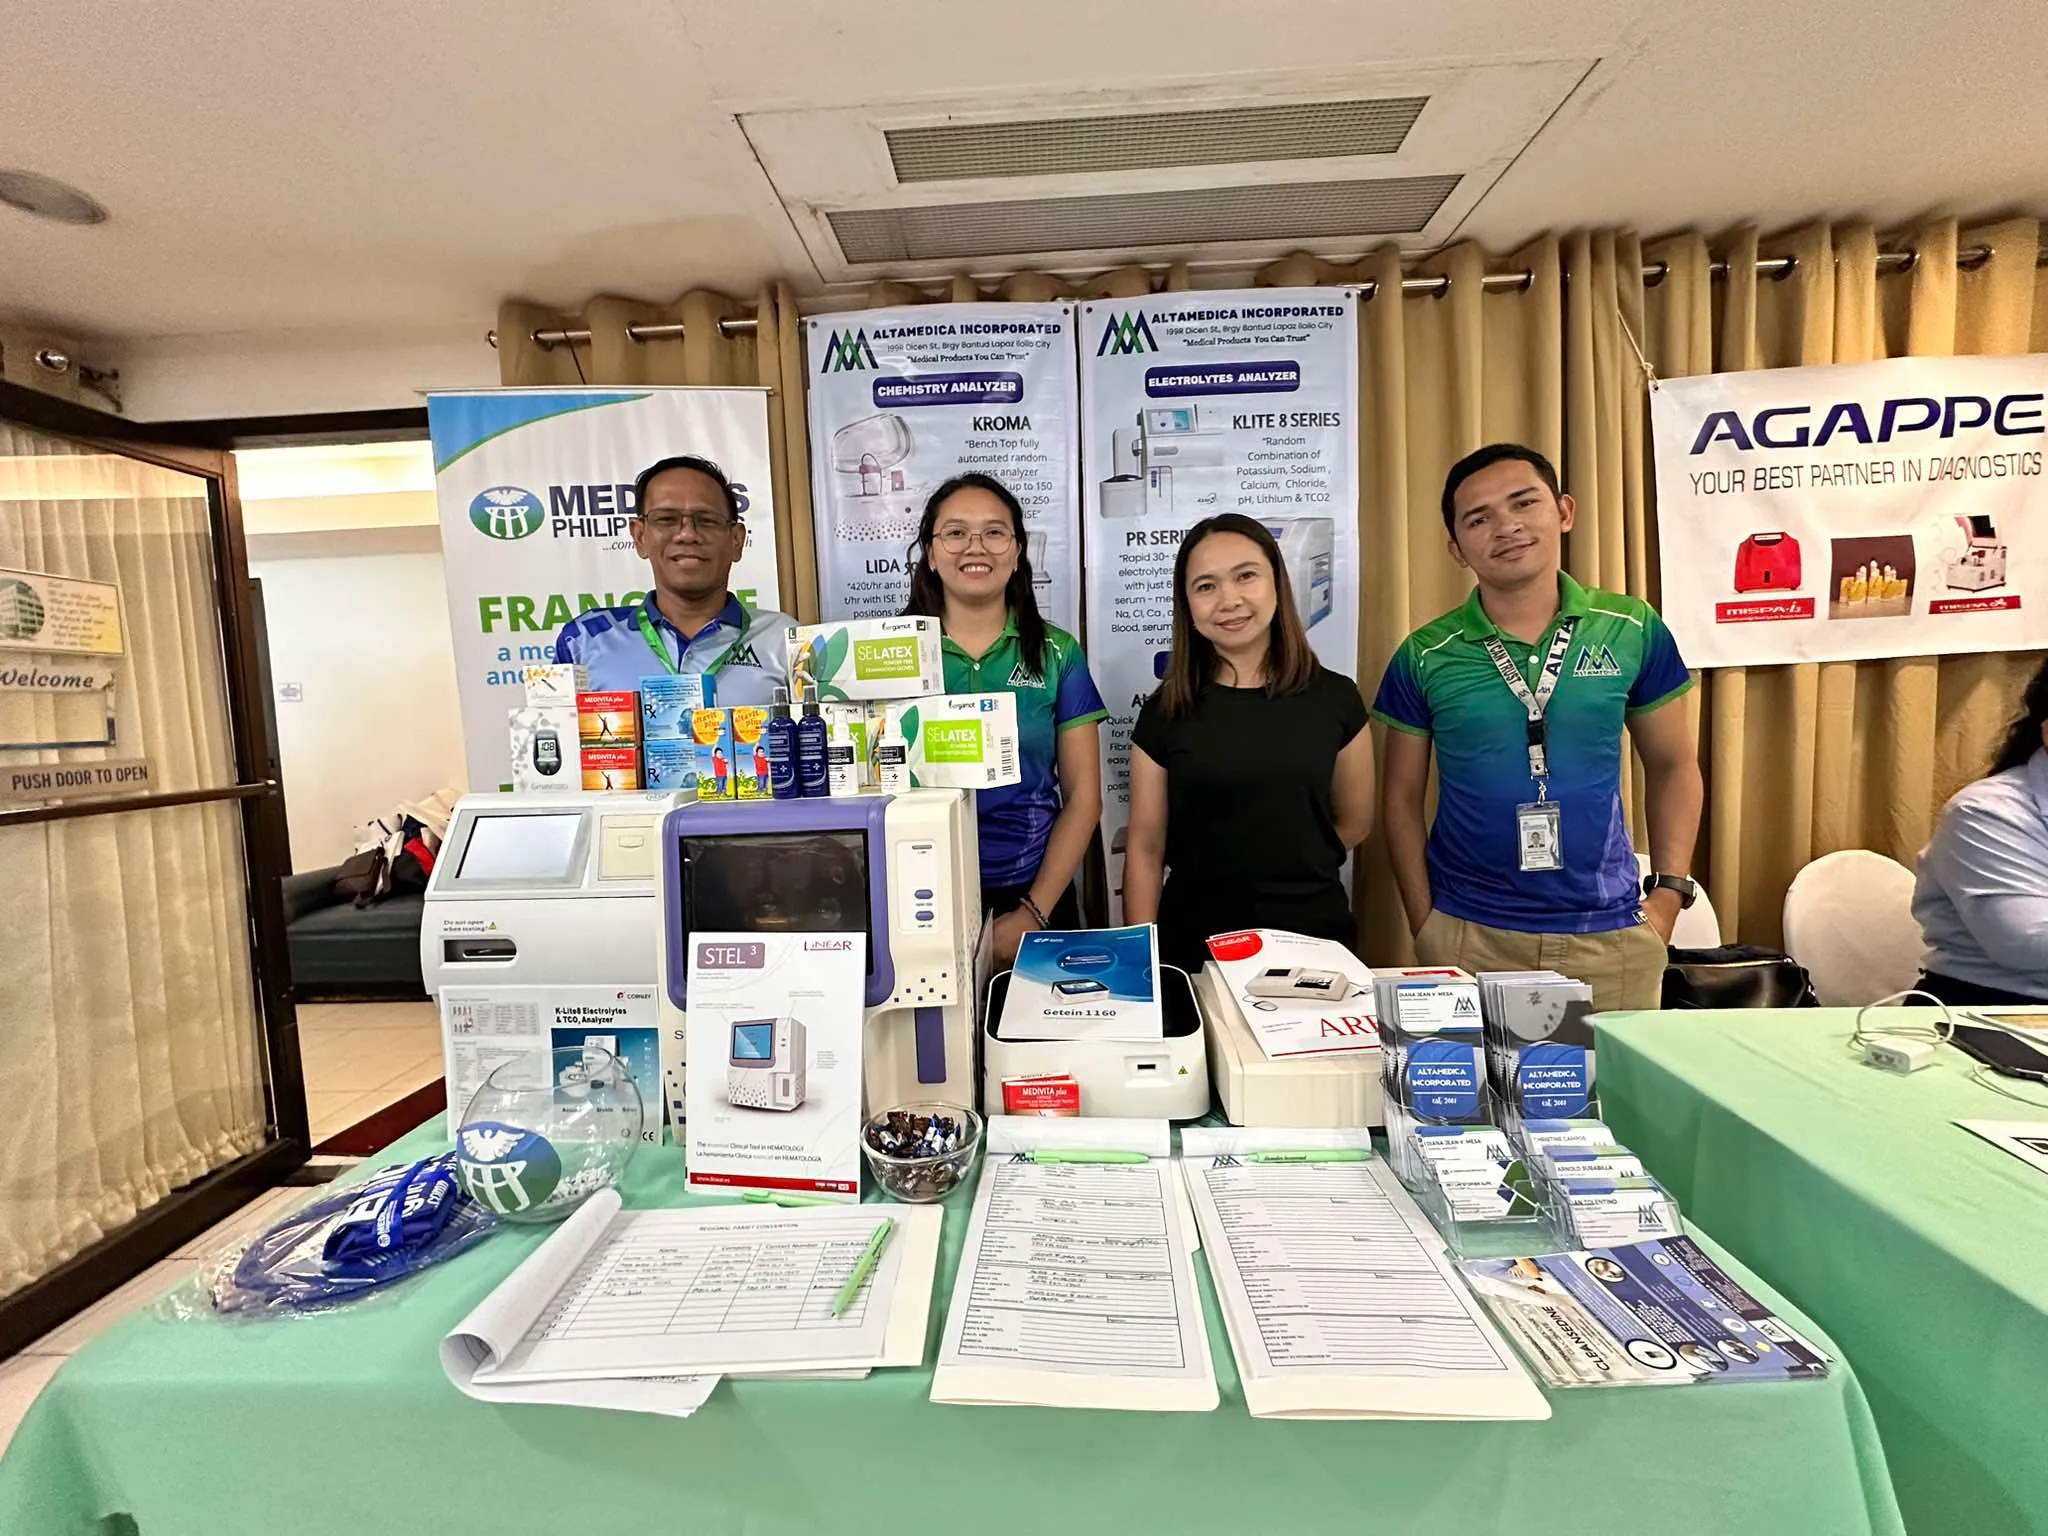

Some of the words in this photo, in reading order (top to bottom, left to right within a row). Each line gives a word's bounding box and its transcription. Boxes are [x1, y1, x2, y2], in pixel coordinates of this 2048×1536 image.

[1151, 309, 1238, 324] ALTAMEDICA
[1242, 306, 1344, 319] INCORPORATED
[873, 325, 957, 340] ALTAMEDICA
[960, 323, 1061, 335] INCORPORATED
[1223, 325, 1241, 335] Brgy
[1273, 323, 1297, 333] Lapaz
[1317, 321, 1333, 331] City
[1035, 339, 1051, 349] City
[1217, 335, 1251, 345] Products
[1254, 335, 1270, 344] You
[1271, 334, 1286, 343] Can
[940, 353, 973, 363] Products
[974, 353, 989, 361] You
[1148, 372, 1234, 388] ELECTROLYTES
[1238, 370, 1298, 383] ANALYZER
[877, 383, 949, 397] CHEMISTRY
[950, 381, 1017, 393] ANALYZER
[972, 415, 1031, 432] KROMA
[1232, 413, 1275, 430] KLITE
[1279, 413, 1288, 428] 8
[1290, 412, 1341, 427] SERIES
[1689, 393, 2045, 455] AGAPPE
[1000, 438, 1018, 450] Top
[1021, 437, 1040, 450] fully
[957, 453, 1009, 464] automated
[1011, 453, 1048, 463] random
[1247, 449, 1309, 462] Combination
[1311, 449, 1321, 460] of
[1000, 468, 1038, 479] analyzer
[1236, 465, 1288, 477] Potassium,
[1689, 469, 1745, 497] YOUR
[1753, 464, 1804, 491] BEST
[1811, 460, 1895, 488] PARTNER
[1903, 457, 1922, 482] IN
[1928, 451, 2043, 482] DIAGNOSTICS
[1024, 482, 1033, 491] to
[1036, 481, 1053, 491] 150
[1240, 480, 1281, 492] Calcium,
[1285, 479, 1328, 490] Chloride,
[1020, 496, 1031, 505] to
[1032, 496, 1050, 505] 250
[1256, 493, 1293, 504] Lithium
[1295, 494, 1303, 503] &
[1305, 492, 1330, 503] TCO2
[1126, 531, 1148, 547] PR
[865, 558, 901, 574] LIDA
[884, 580, 902, 590] and
[1124, 581, 1145, 590] with
[1146, 581, 1165, 592] just
[862, 594, 882, 604] with
[883, 594, 897, 603] ISE
[1114, 596, 1146, 605] serum
[853, 608, 893, 620] positions
[1111, 623, 1141, 633] Blood,
[858, 644, 913, 661] SELATEX
[1499, 659, 1522, 685] TRUST
[1107, 715, 1134, 726] Quick
[927, 727, 977, 743] SELATEX
[1111, 729, 1124, 738] for
[12, 773, 51, 791] PUSH
[56, 769, 93, 787] DOOR
[96, 768, 112, 784] TO
[116, 765, 149, 783] OPEN
[704, 947, 746, 965] STEL
[750, 945, 758, 956] 3
[582, 1006, 627, 1016] Electrolytes
[1043, 1008, 1083, 1017] Getein
[1085, 1008, 1117, 1018] 1160
[582, 1015, 613, 1025] Analyzer
[1417, 1068, 1467, 1076] ALTAMEDICA
[1528, 1071, 1577, 1079] ALTAMEDICA
[1412, 1079, 1472, 1087] INCORPORATED
[1523, 1081, 1581, 1090] INCORPORATED
[1022, 1087, 1055, 1096] MEDIVITA
